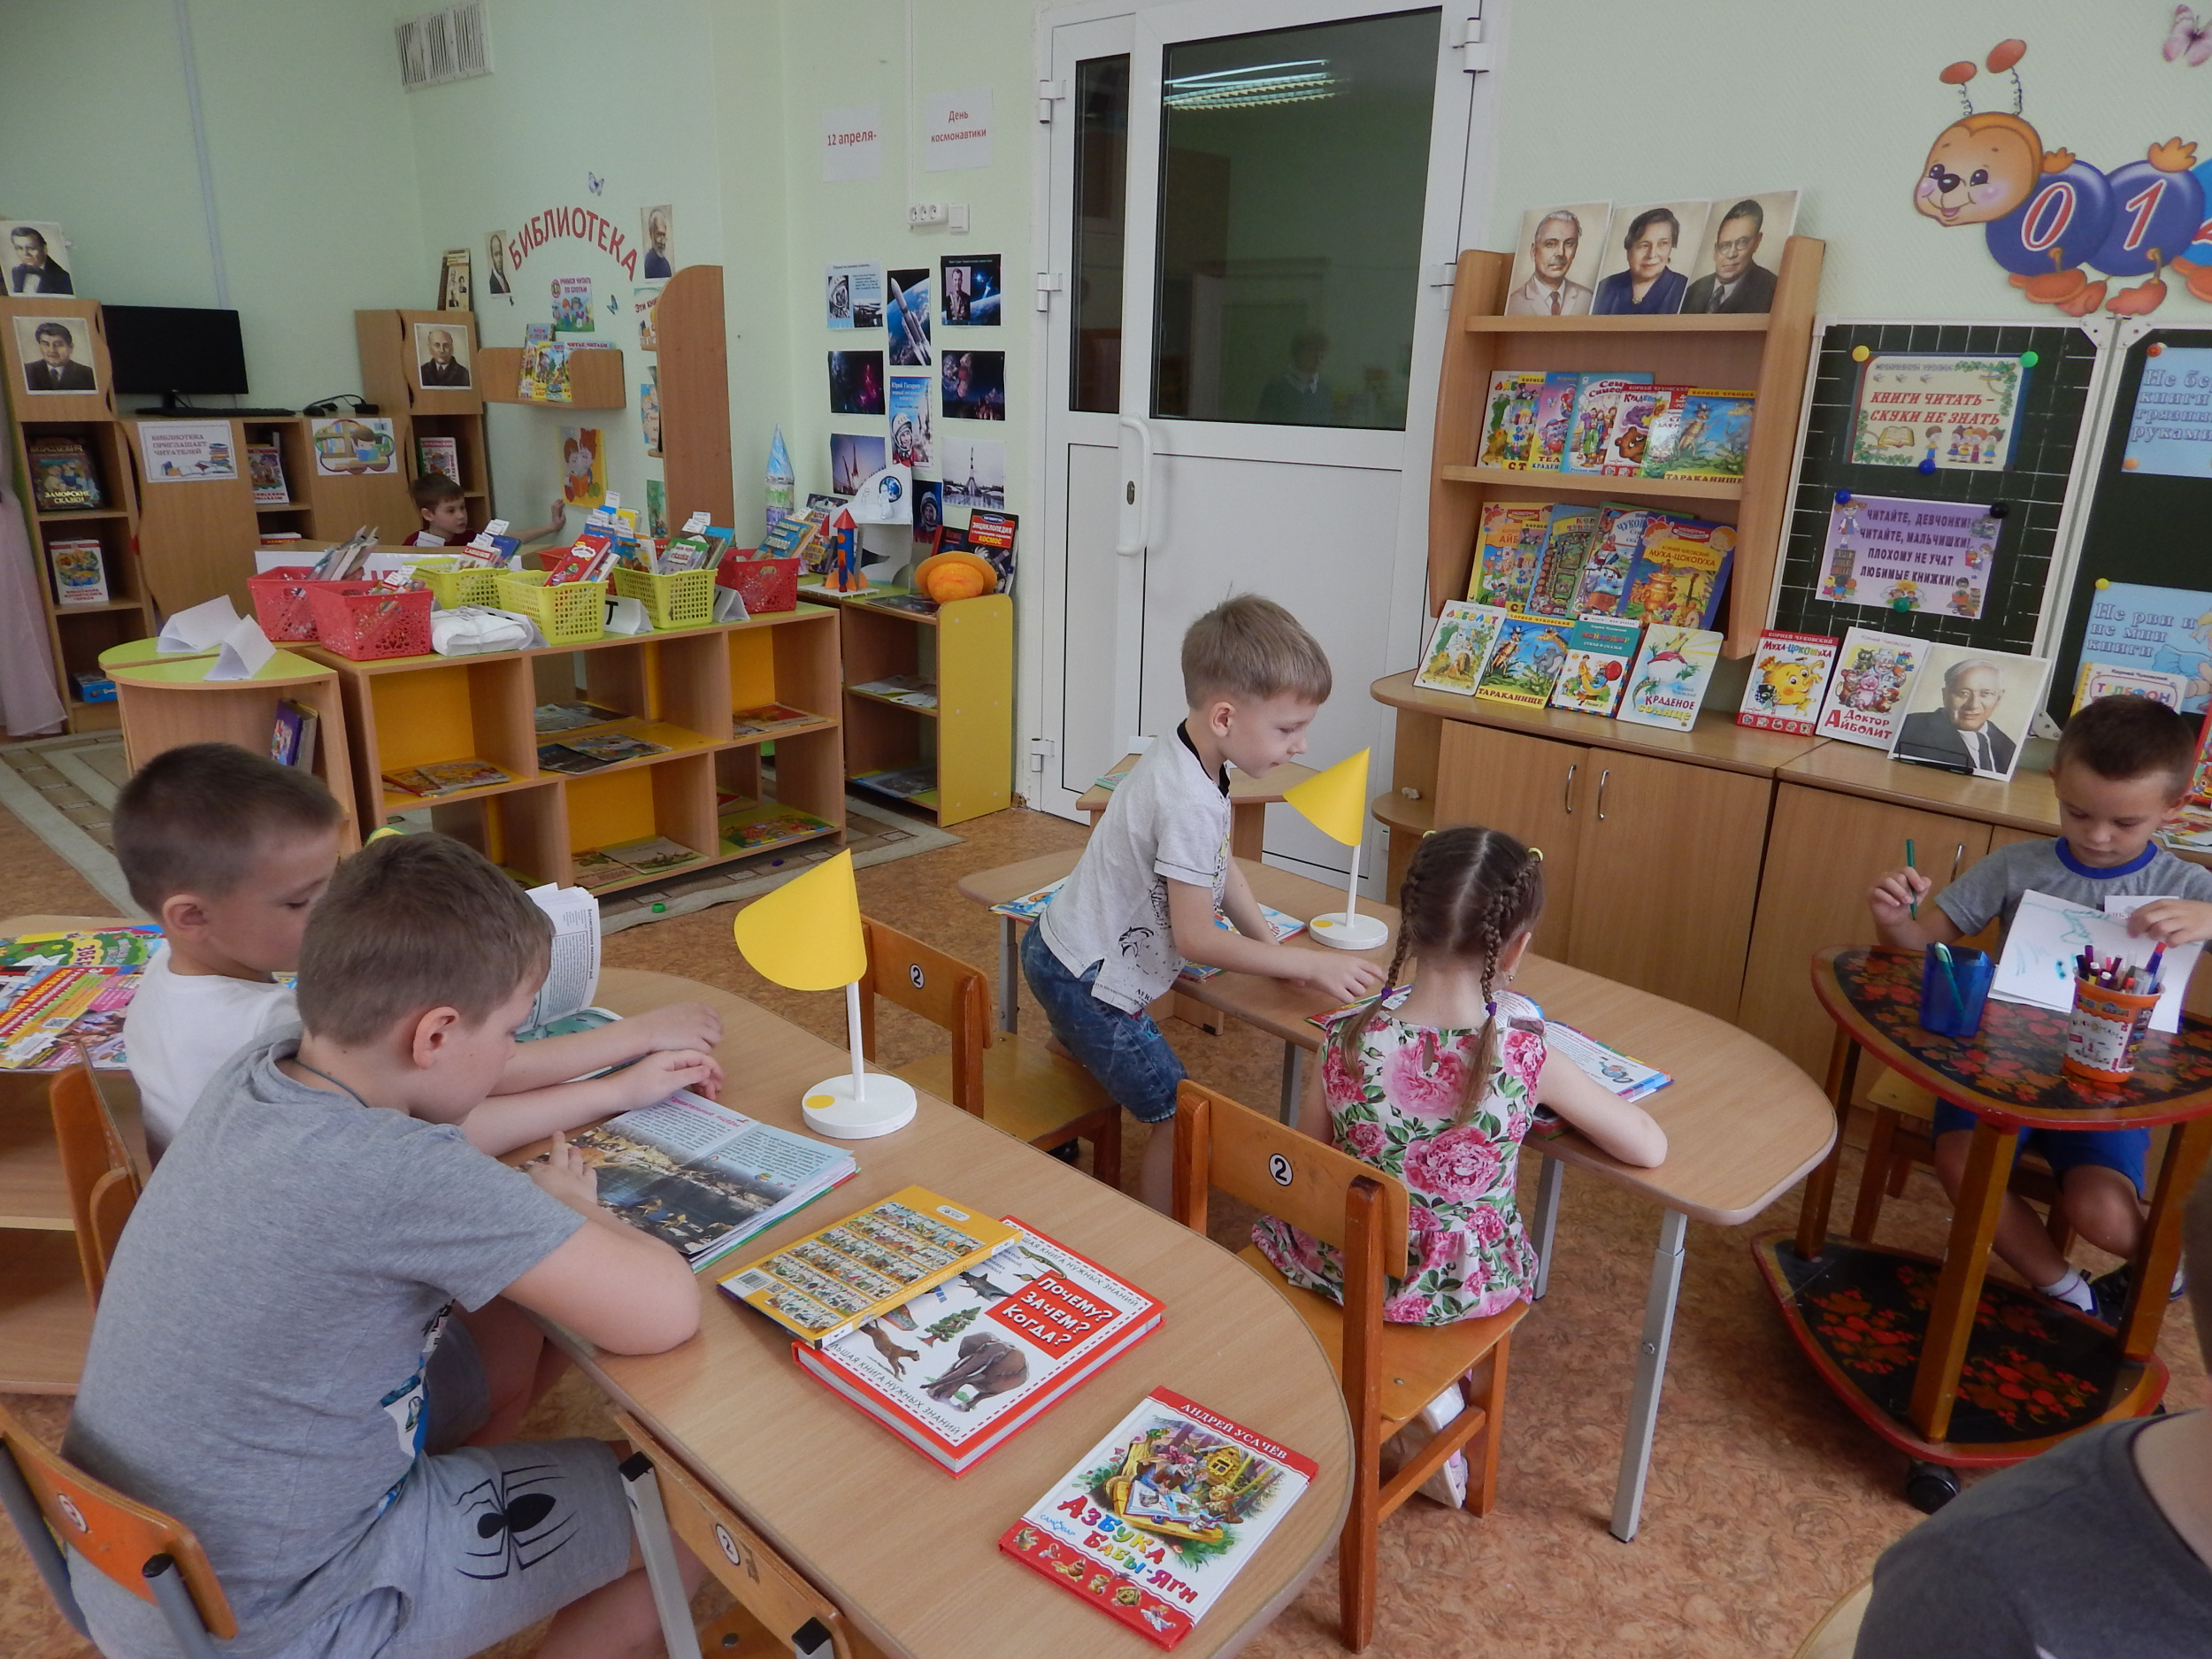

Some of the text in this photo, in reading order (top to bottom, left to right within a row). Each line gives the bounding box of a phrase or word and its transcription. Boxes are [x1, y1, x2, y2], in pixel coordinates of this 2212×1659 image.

[949, 110, 969, 123] День
[827, 131, 877, 146] 12 апреля-
[931, 128, 987, 143] космонавтики
[2022, 179, 2167, 251] 0 1
[508, 206, 638, 281] БИБЛИОТЕКА
[2143, 368, 2177, 387] Не
[1870, 392, 1919, 404] КНИГИ
[1924, 393, 1982, 406] ЧИТАТЬ
[2139, 391, 2209, 406] книги
[1870, 410, 2000, 426] СКУКИ НЕ ЗНАТЬ
[2136, 409, 2212, 424] грязны
[972, 522, 1013, 534] ЭНЦИКЛОПЕДИЯ
[1867, 510, 1971, 528] ЧИТАЙТЕ, ДЕВЧОНКИ!
[979, 535, 1002, 545] КОСМОС
[1500, 534, 1518, 543] АЙБ
[1860, 528, 1971, 549] ЧИТАЙТЕ, МАЛЬЧИШКИ!
[1649, 549, 1716, 566] МУХА-ЦОКОТУХА
[1868, 548, 1954, 567] ПЛОХОМУ НЕ УЧАТ
[1860, 565, 1955, 587] ЛЮБИМЫЕ КНИЖКИ!
[1446, 609, 1499, 625] АЙБОЛИТ
[1535, 618, 1571, 626] ЧУКОВСКИЙ
[2095, 603, 2197, 629] Не рви и
[1794, 634, 1833, 644] ЧУКОВСКИЙ
[2091, 623, 2168, 643] не мни
[2086, 640, 2154, 657] книги
[1478, 687, 1544, 705] ТАРАКАНИЩЕ
[1645, 695, 1695, 710] КРАДЕНОЕ
[913, 967, 921, 986] 2
[1274, 1157, 1287, 1182] 2
[1040, 1246, 1065, 1264] КНИГА
[1066, 1262, 1102, 1286] НУЖНЫХ
[1102, 1281, 1140, 1307] ЗНАНИЙ
[1037, 1277, 1113, 1322] ПОЧЕМУ?
[1020, 1291, 1091, 1333] ЗАЧЕМ?
[1002, 1304, 1072, 1346] КОГДА?
[858, 1361, 886, 1381] КНИГА
[886, 1379, 925, 1409] НУЖНЫХ
[922, 1406, 961, 1435] ЗНАНИЙ
[1180, 1402, 1287, 1460] АНДРЕЙ УСАЧЁВ
[1056, 1494, 1166, 1565] АЗБУКА
[722, 1534, 733, 1555] 2
[1083, 1530, 1199, 1604] БАБЫ-ЯГИ
